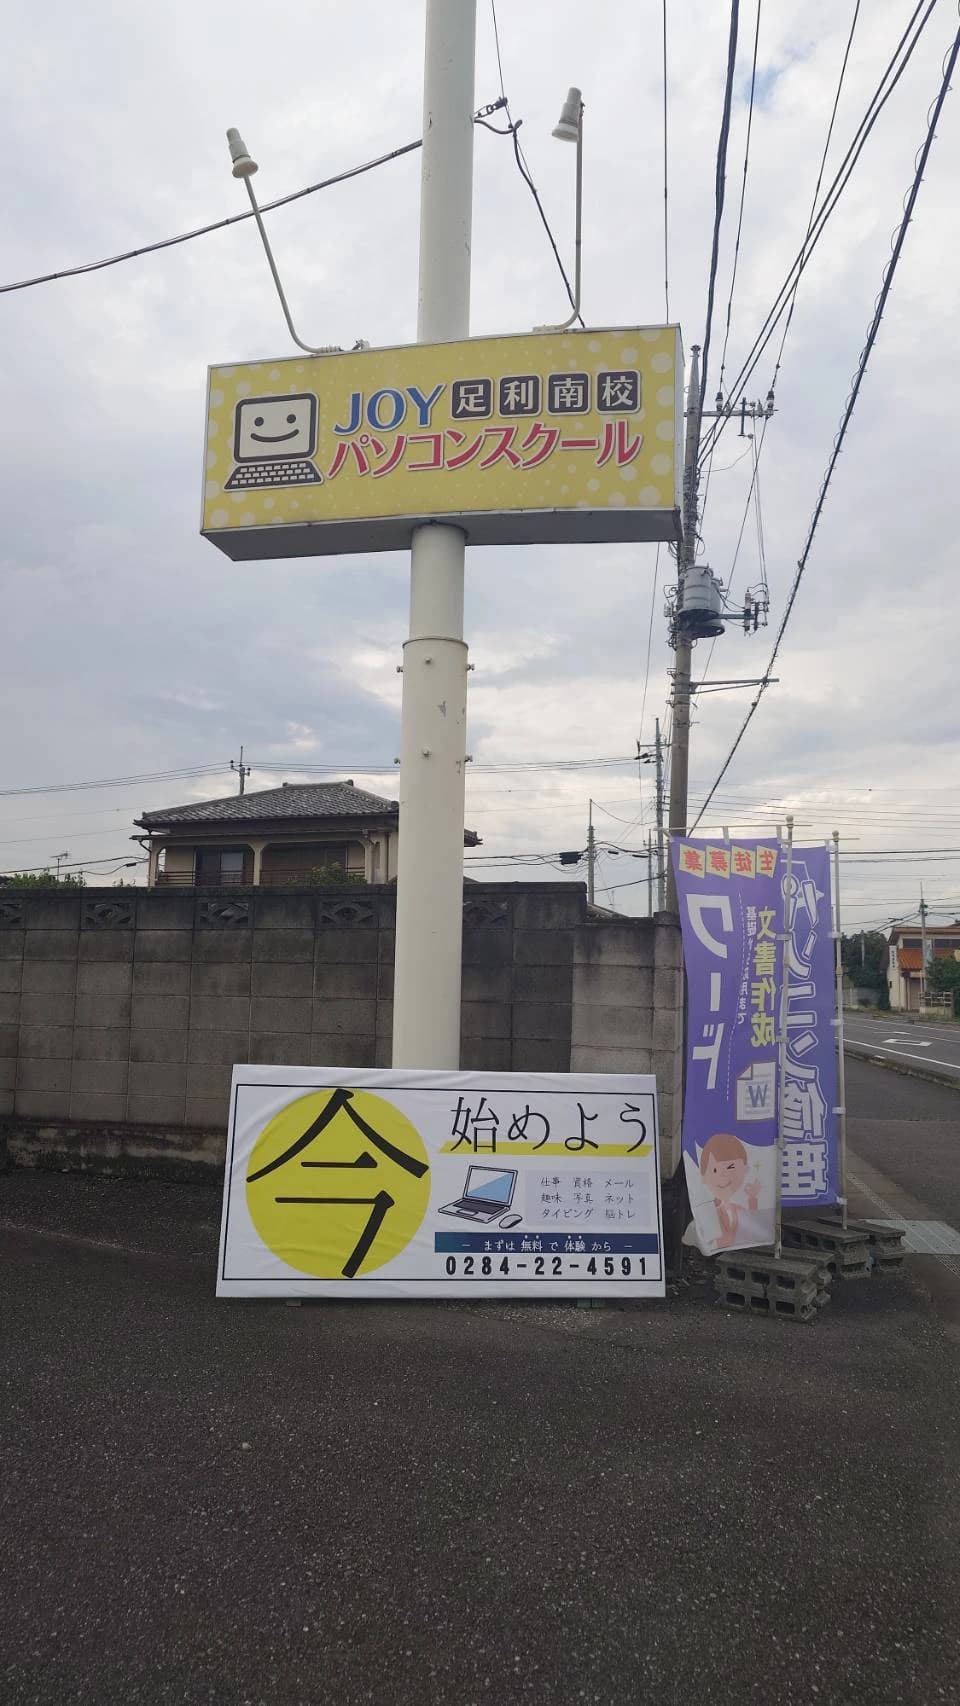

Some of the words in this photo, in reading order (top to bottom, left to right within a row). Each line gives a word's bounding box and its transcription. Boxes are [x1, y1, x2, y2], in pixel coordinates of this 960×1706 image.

[333, 383, 446, 435] JOY
[454, 373, 637, 415] 足利南校
[327, 421, 643, 479] パソコンスクール
[449, 1096, 648, 1154] 始めよう
[246, 1087, 430, 1280] 今
[540, 1177, 561, 1187] 仕事
[573, 1177, 593, 1188] 資格
[604, 1178, 634, 1188] メール
[540, 1192, 562, 1203] 趣味
[573, 1192, 593, 1203] 写真
[604, 1193, 634, 1204] ネット
[542, 1208, 594, 1219] タイピング
[605, 1208, 635, 1219] 脳トレ
[483, 1240, 515, 1252] まずは
[520, 1240, 543, 1252] 無料
[549, 1241, 559, 1252] で
[564, 1240, 587, 1252] 体験
[591, 1241, 612, 1252] から
[445, 1255, 648, 1277] 0284-22-4591
